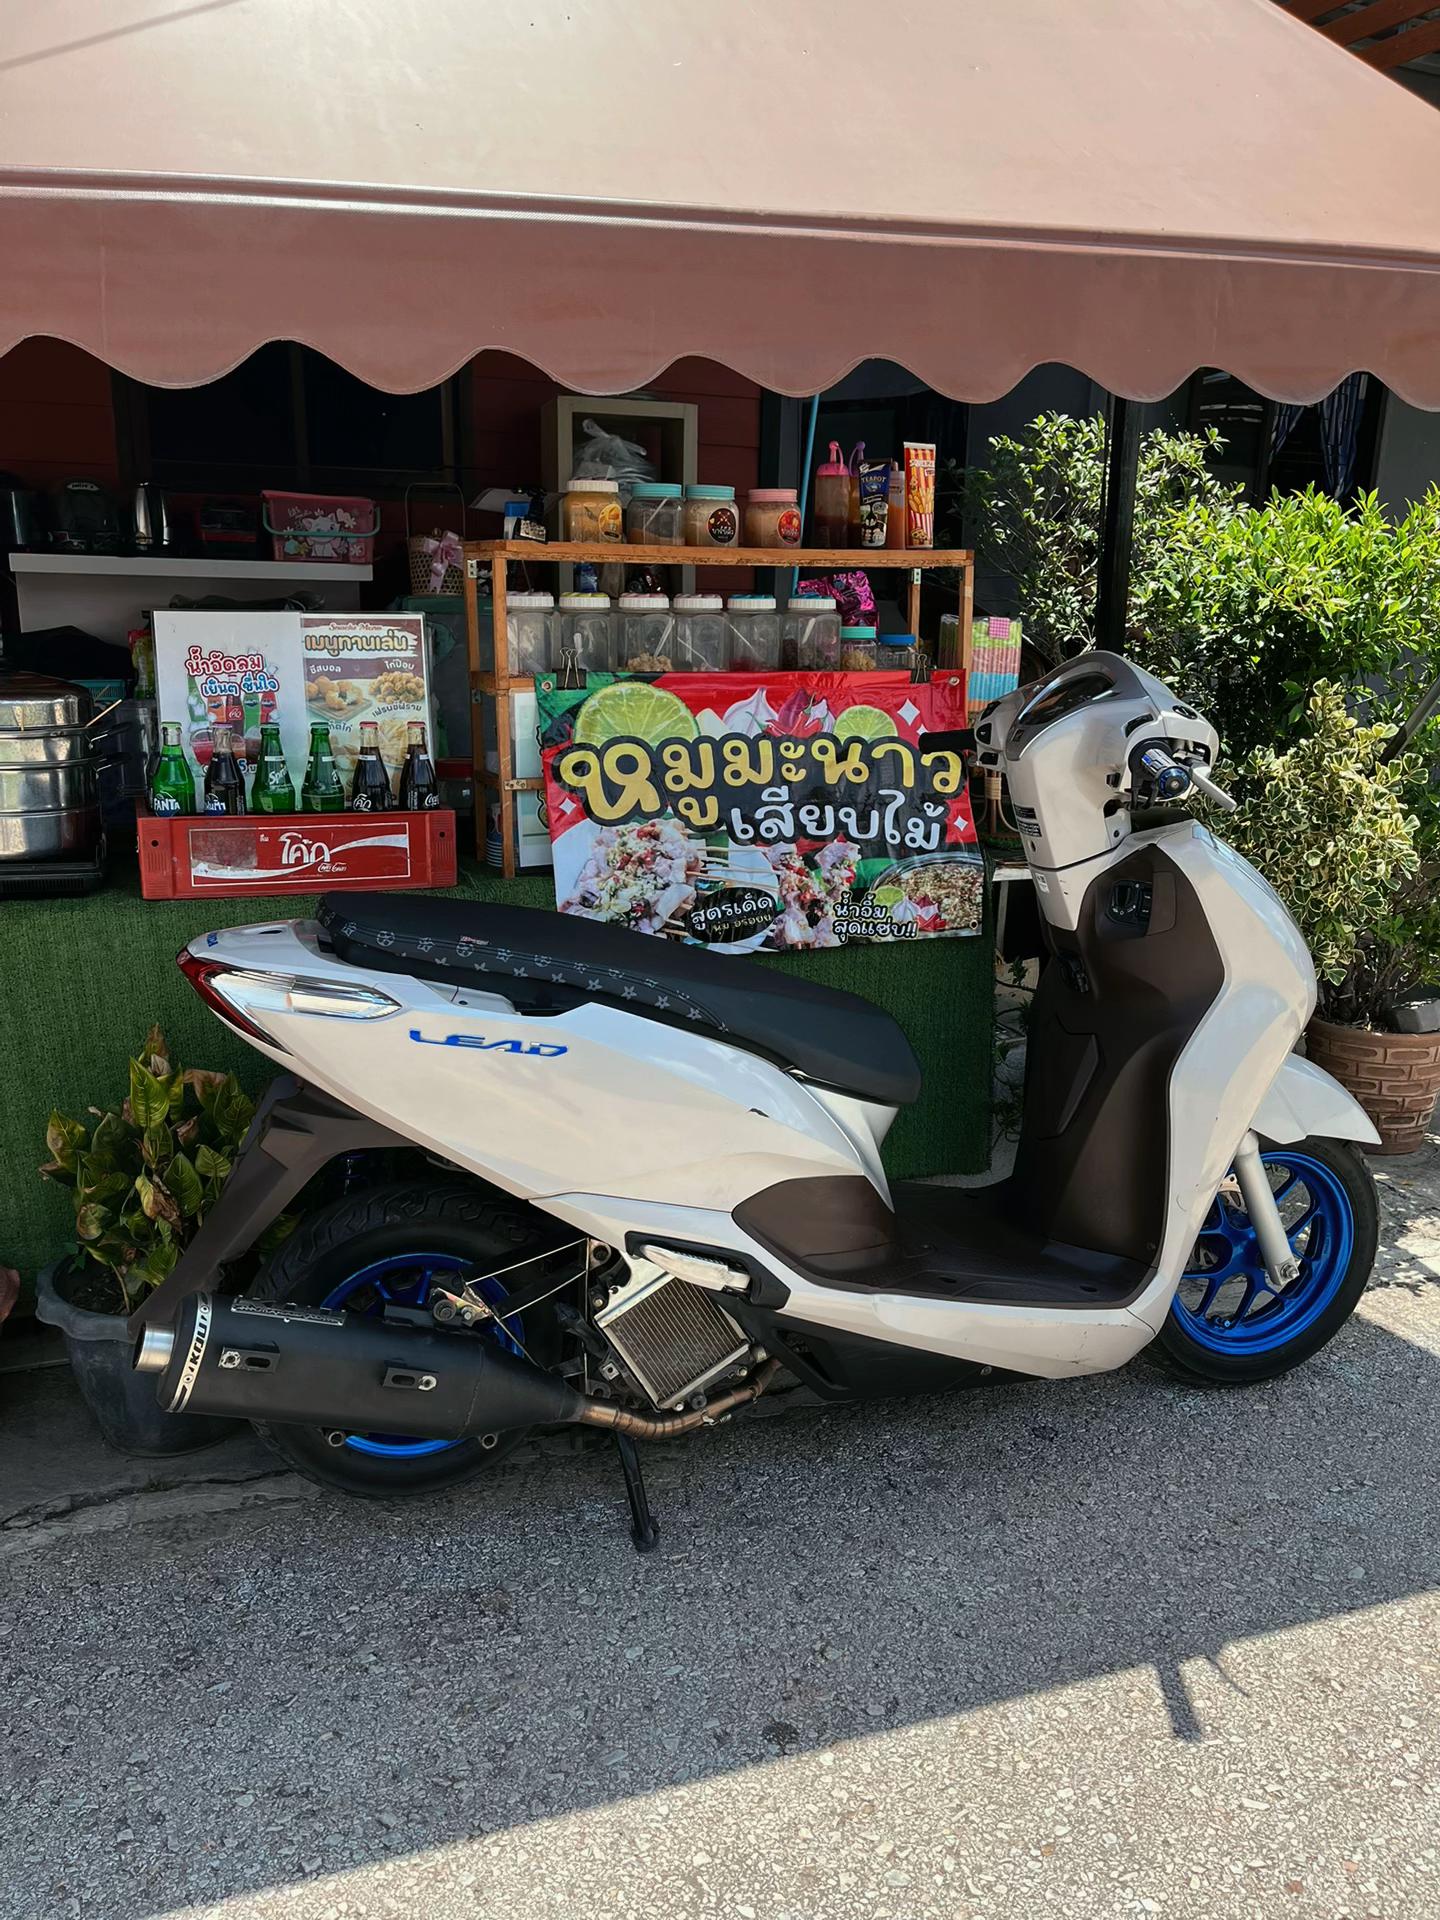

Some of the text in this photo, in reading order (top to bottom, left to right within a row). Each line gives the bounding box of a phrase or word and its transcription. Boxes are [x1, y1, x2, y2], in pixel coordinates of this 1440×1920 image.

[305, 629, 408, 657] เมนูทานเล่น
[186, 647, 263, 675] น้ำอัดลม
[203, 672, 279, 696] เย็นๆ ชื่นใจ
[560, 738, 962, 826] หมูมะนาว
[154, 797, 180, 811] FANTA
[731, 786, 945, 851] เสียบไม้
[279, 832, 331, 864] โค้ก
[691, 893, 773, 930] สูตรเด็ด
[834, 891, 887, 918] น้ำจิ้ม
[834, 917, 918, 942] สุดแซ่บ!!
[409, 1029, 568, 1057] LEAD
